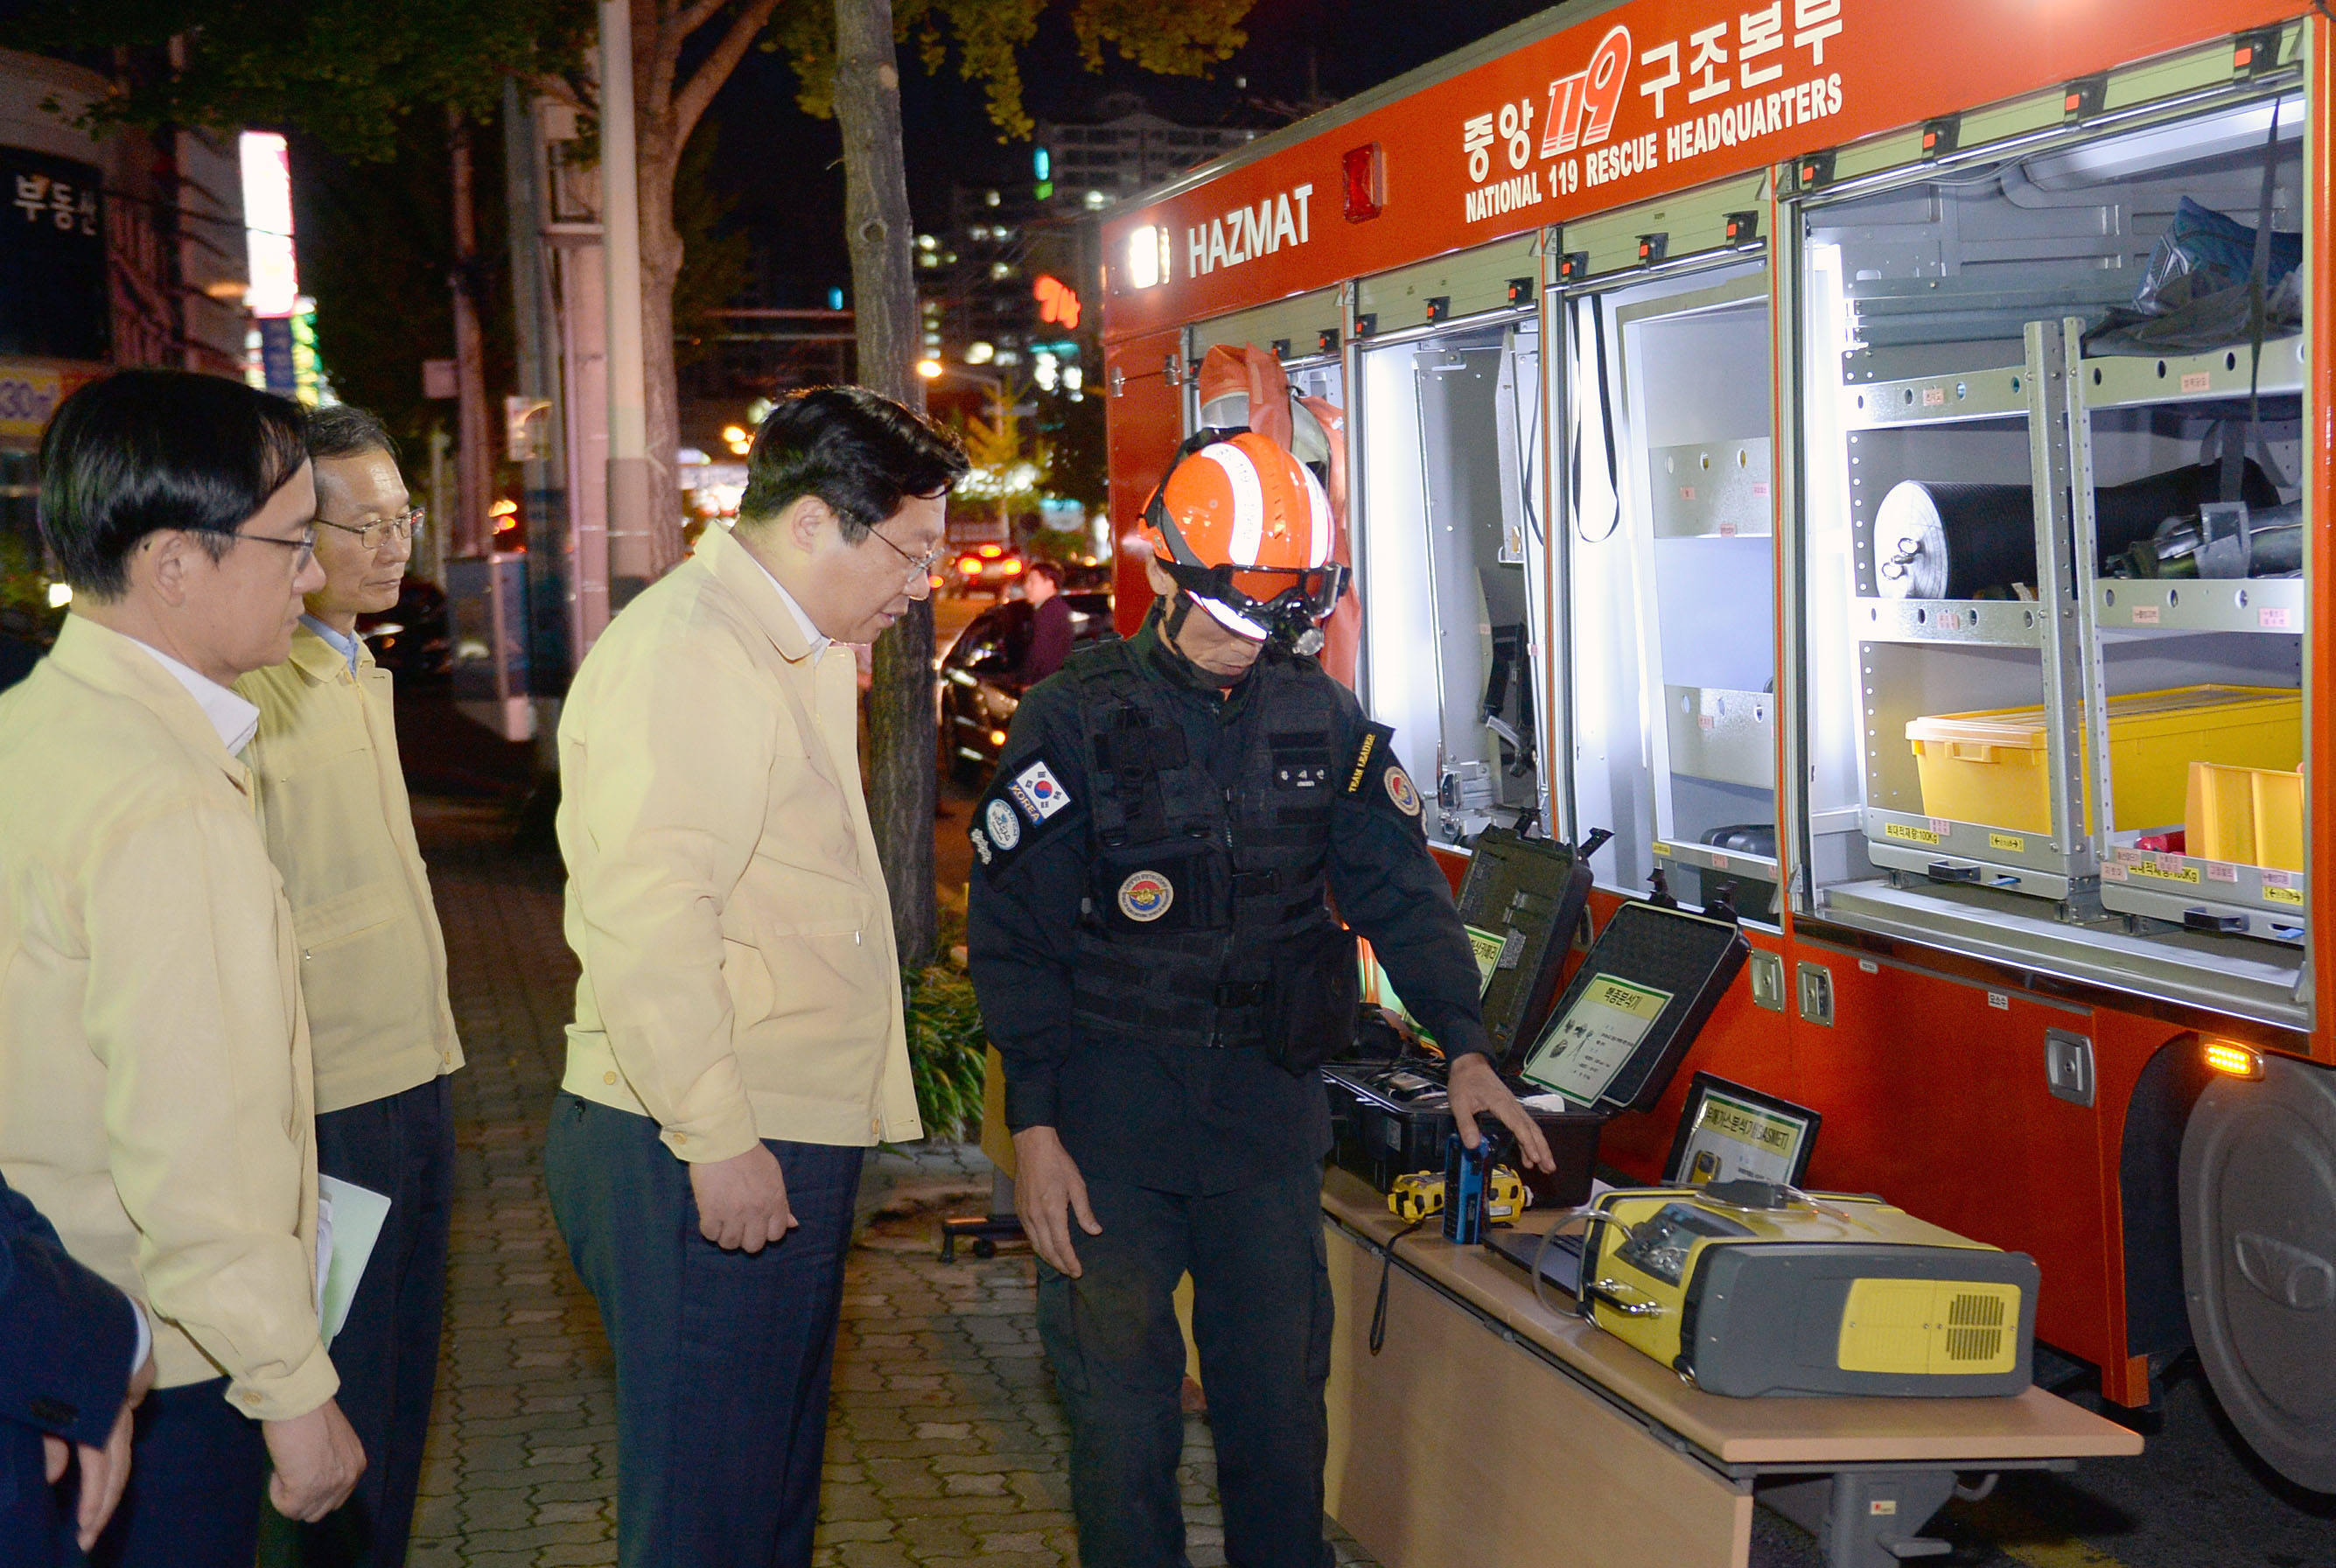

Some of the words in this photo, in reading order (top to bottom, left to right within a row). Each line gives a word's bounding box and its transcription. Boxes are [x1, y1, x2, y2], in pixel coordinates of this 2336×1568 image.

[1464, 98, 1534, 183] 중앙
[1540, 24, 1632, 159] 119
[1640, 0, 1843, 119] 구조본부
[1465, 172, 1542, 223] NATIONAL
[1549, 159, 1578, 198] 119
[1586, 132, 1658, 187] RESCUE
[1667, 73, 1843, 164] HEADQUARTERS
[1189, 184, 1312, 278] HAZMAT
[1011, 785, 1039, 822] KOREA
[1347, 767, 1366, 793] TEAM
[1357, 733, 1376, 767] LEADER
